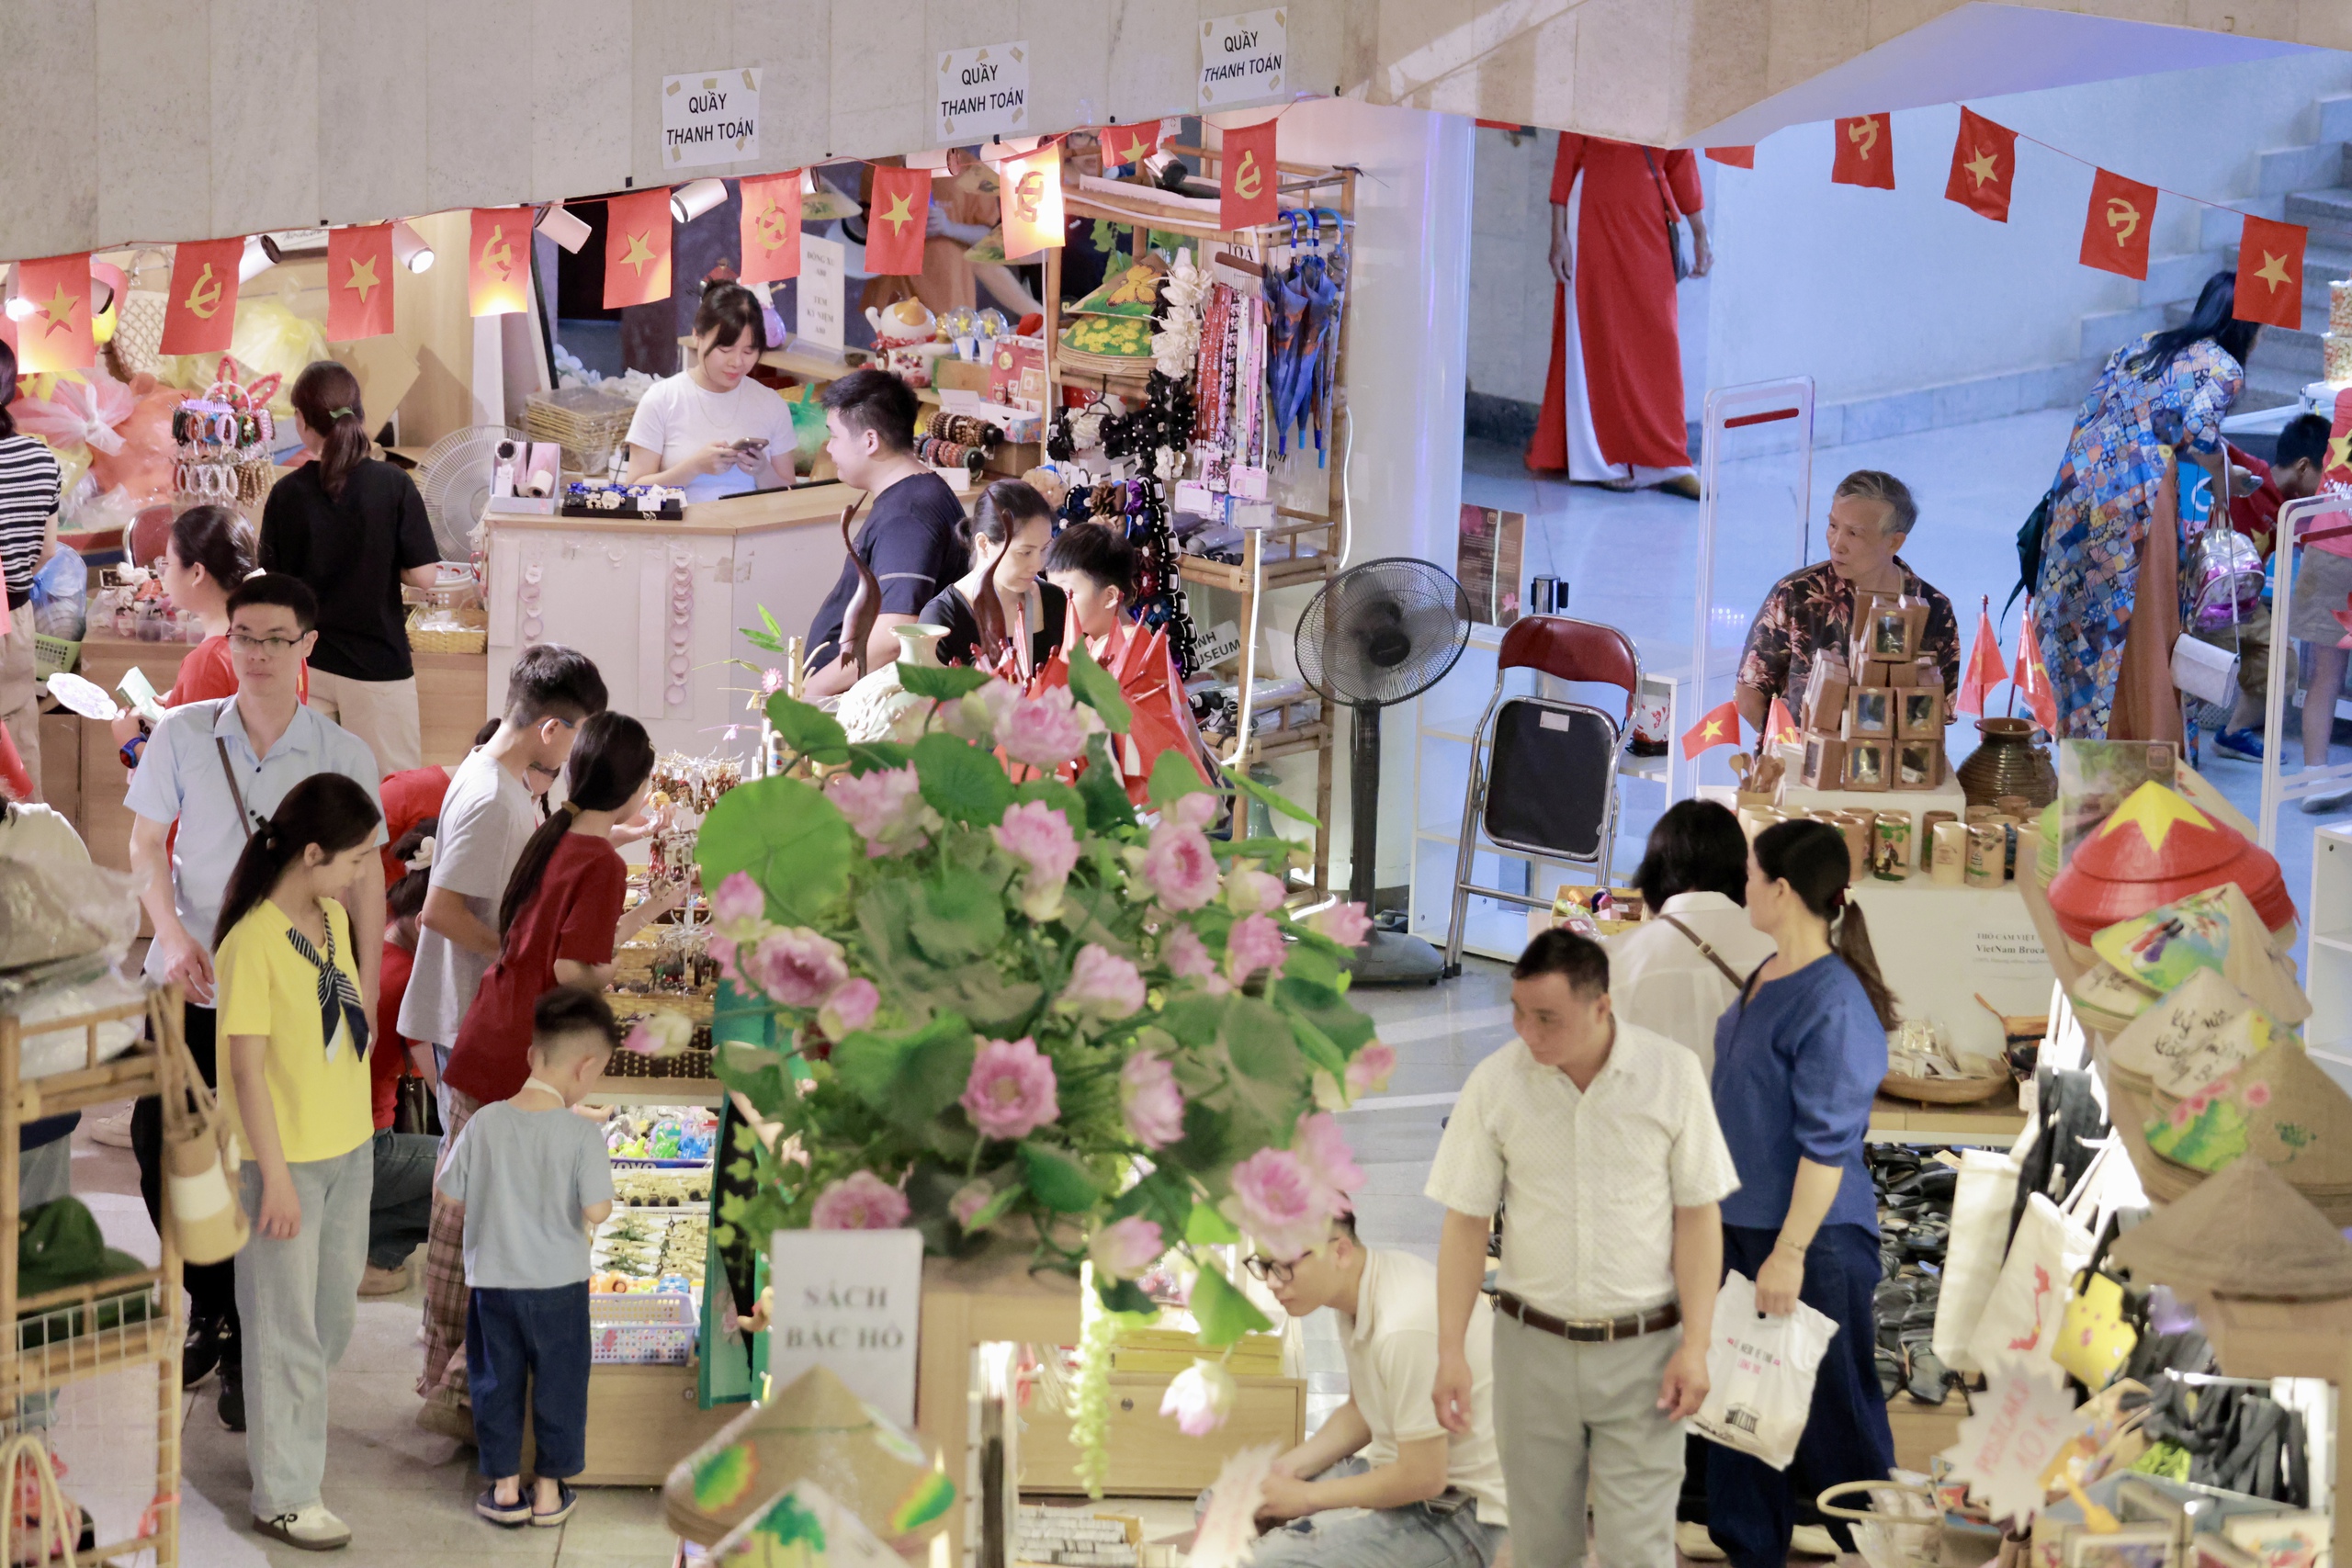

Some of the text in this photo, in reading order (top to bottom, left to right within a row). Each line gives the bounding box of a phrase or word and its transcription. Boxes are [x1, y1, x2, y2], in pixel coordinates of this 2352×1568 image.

[1225, 29, 1258, 52] QUẦY
[961, 62, 998, 85] QUẦY
[1204, 52, 1282, 82] THANH TOÁN
[689, 91, 727, 114] QUẦY
[941, 87, 1023, 117] THANH TOÁN
[666, 117, 753, 145] THANH TOÁN
[1198, 638, 1240, 665] USEUM
[1976, 944, 2045, 953] VietNam Broca
[804, 1280, 888, 1308] SÁCH
[786, 1321, 849, 1348] BÁC
